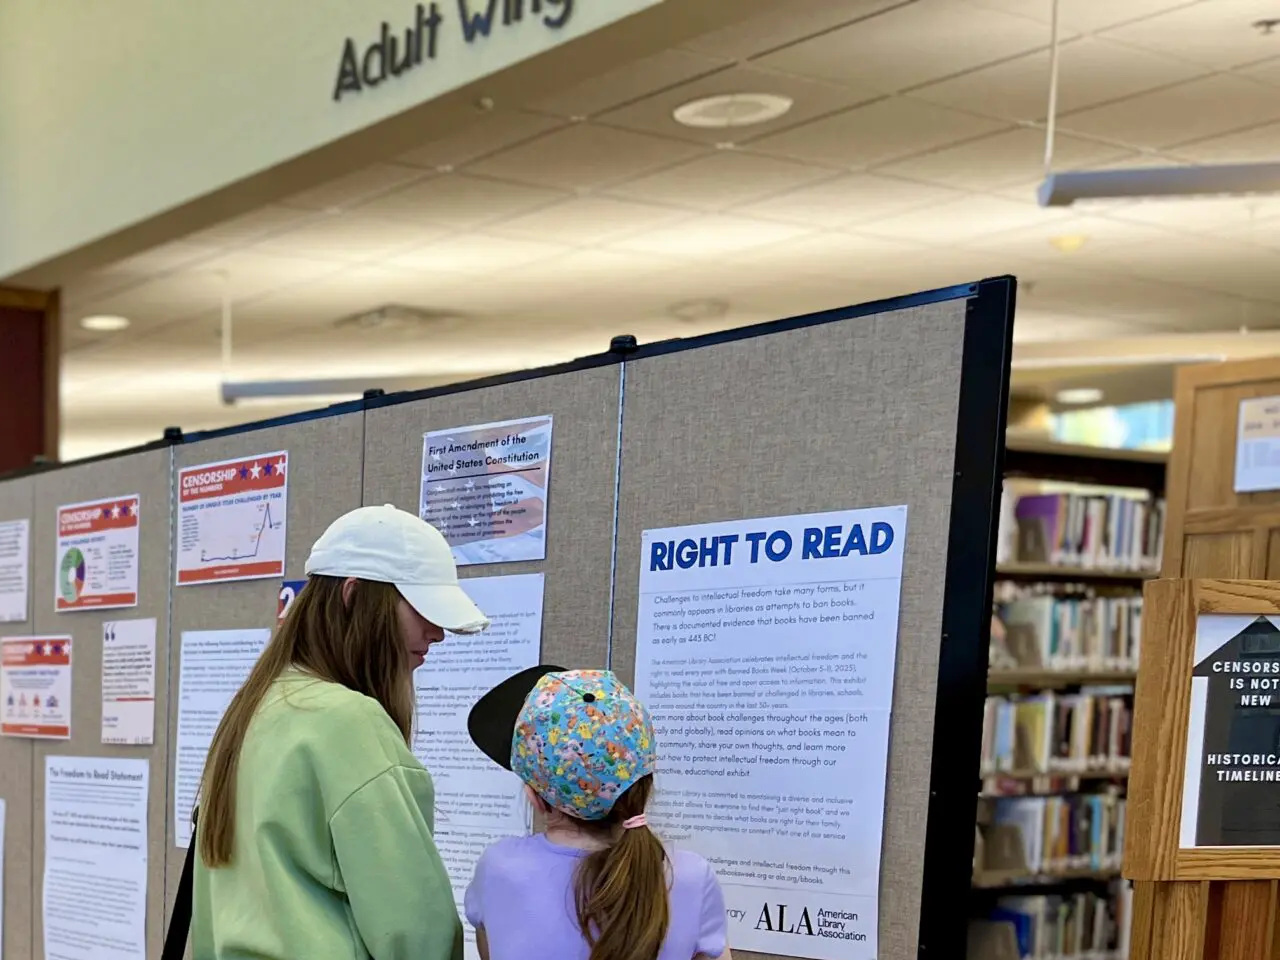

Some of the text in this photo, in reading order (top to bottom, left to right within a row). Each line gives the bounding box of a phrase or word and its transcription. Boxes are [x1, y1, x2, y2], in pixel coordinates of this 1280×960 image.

[332, 0, 574, 102] Adult Wing
[429, 434, 526, 456] First Amendment of the
[427, 451, 539, 473] United States Constitution
[183, 468, 237, 488] CENSORSHIP
[649, 522, 895, 572] RIGHT TO READ
[654, 596, 691, 604] Challenges
[701, 590, 739, 601] intellectual
[741, 589, 772, 597] freedom
[775, 587, 791, 596] take
[793, 587, 814, 596] many
[817, 585, 841, 593] forms,
[843, 584, 856, 592] but
[653, 608, 685, 618] commonly
[688, 608, 715, 616] appears
[725, 605, 753, 613] libraries
[765, 602, 800, 612] attempts
[813, 600, 828, 608] ban
[653, 623, 670, 631] There
[678, 620, 721, 629] documented
[723, 619, 755, 627] evidence
[757, 617, 772, 625] that
[774, 617, 796, 625] books
[799, 615, 817, 623] have
[820, 614, 840, 622] been
[843, 611, 875, 621] banned
[661, 637, 677, 645] early
[1213, 661, 1280, 673] CENSORS
[1230, 678, 1279, 690] IS NOT
[1241, 695, 1271, 706] NEW
[686, 713, 706, 721] about
[708, 713, 724, 721] book
[726, 713, 764, 723] challenges
[766, 713, 807, 724] throughout
[809, 713, 822, 722] the
[824, 715, 844, 723] ages
[846, 713, 868, 723] (both
[654, 726, 668, 736] cally
[717, 727, 733, 735] read
[735, 728, 764, 736] opinions
[777, 728, 796, 736] what
[798, 728, 821, 736] books
[659, 741, 697, 750] community,
[698, 741, 717, 749] share
[719, 742, 733, 750] your
[752, 742, 784, 752] thoughts,
[787, 743, 801, 751] and
[803, 743, 823, 751] learn
[692, 755, 717, 763] protect
[719, 755, 757, 764] intellectual
[759, 756, 790, 765] freedom
[792, 757, 821, 767] through
[1207, 754, 1280, 765] HISTORICA
[60, 768, 84, 778] Freedom
[86, 770, 92, 779] to
[94, 769, 110, 780] Read
[110, 770, 143, 781] Statement
[685, 767, 725, 776] educational
[1217, 770, 1280, 781] TIMELINE
[739, 859, 751, 867] and
[752, 860, 785, 869] intellectual
[785, 863, 811, 871] freedom
[813, 865, 838, 875] through
[839, 867, 851, 875] this
[726, 901, 816, 936] rary ALA
[817, 908, 858, 921] American
[817, 918, 846, 931] Library
[817, 928, 867, 941] Association
